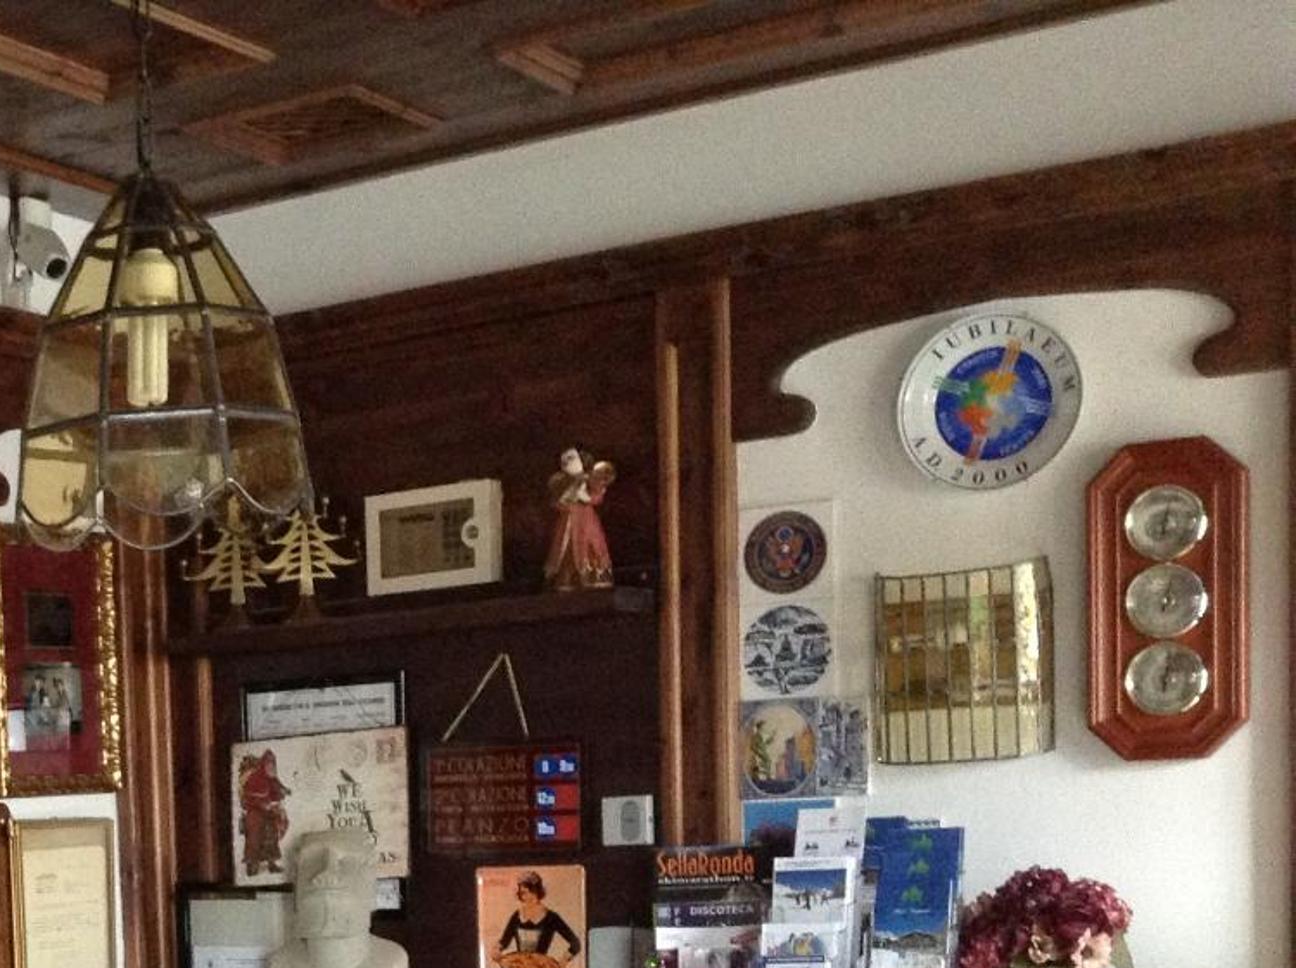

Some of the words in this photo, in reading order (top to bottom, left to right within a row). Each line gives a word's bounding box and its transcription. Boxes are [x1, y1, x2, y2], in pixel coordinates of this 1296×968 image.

[932, 319, 1077, 392] IUBILAEUM
[950, 461, 1029, 486] 2000
[337, 782, 362, 799] WE
[331, 799, 368, 816] WISH
[657, 848, 755, 879] SellaRonda
[689, 904, 755, 917] DISCOTECA
